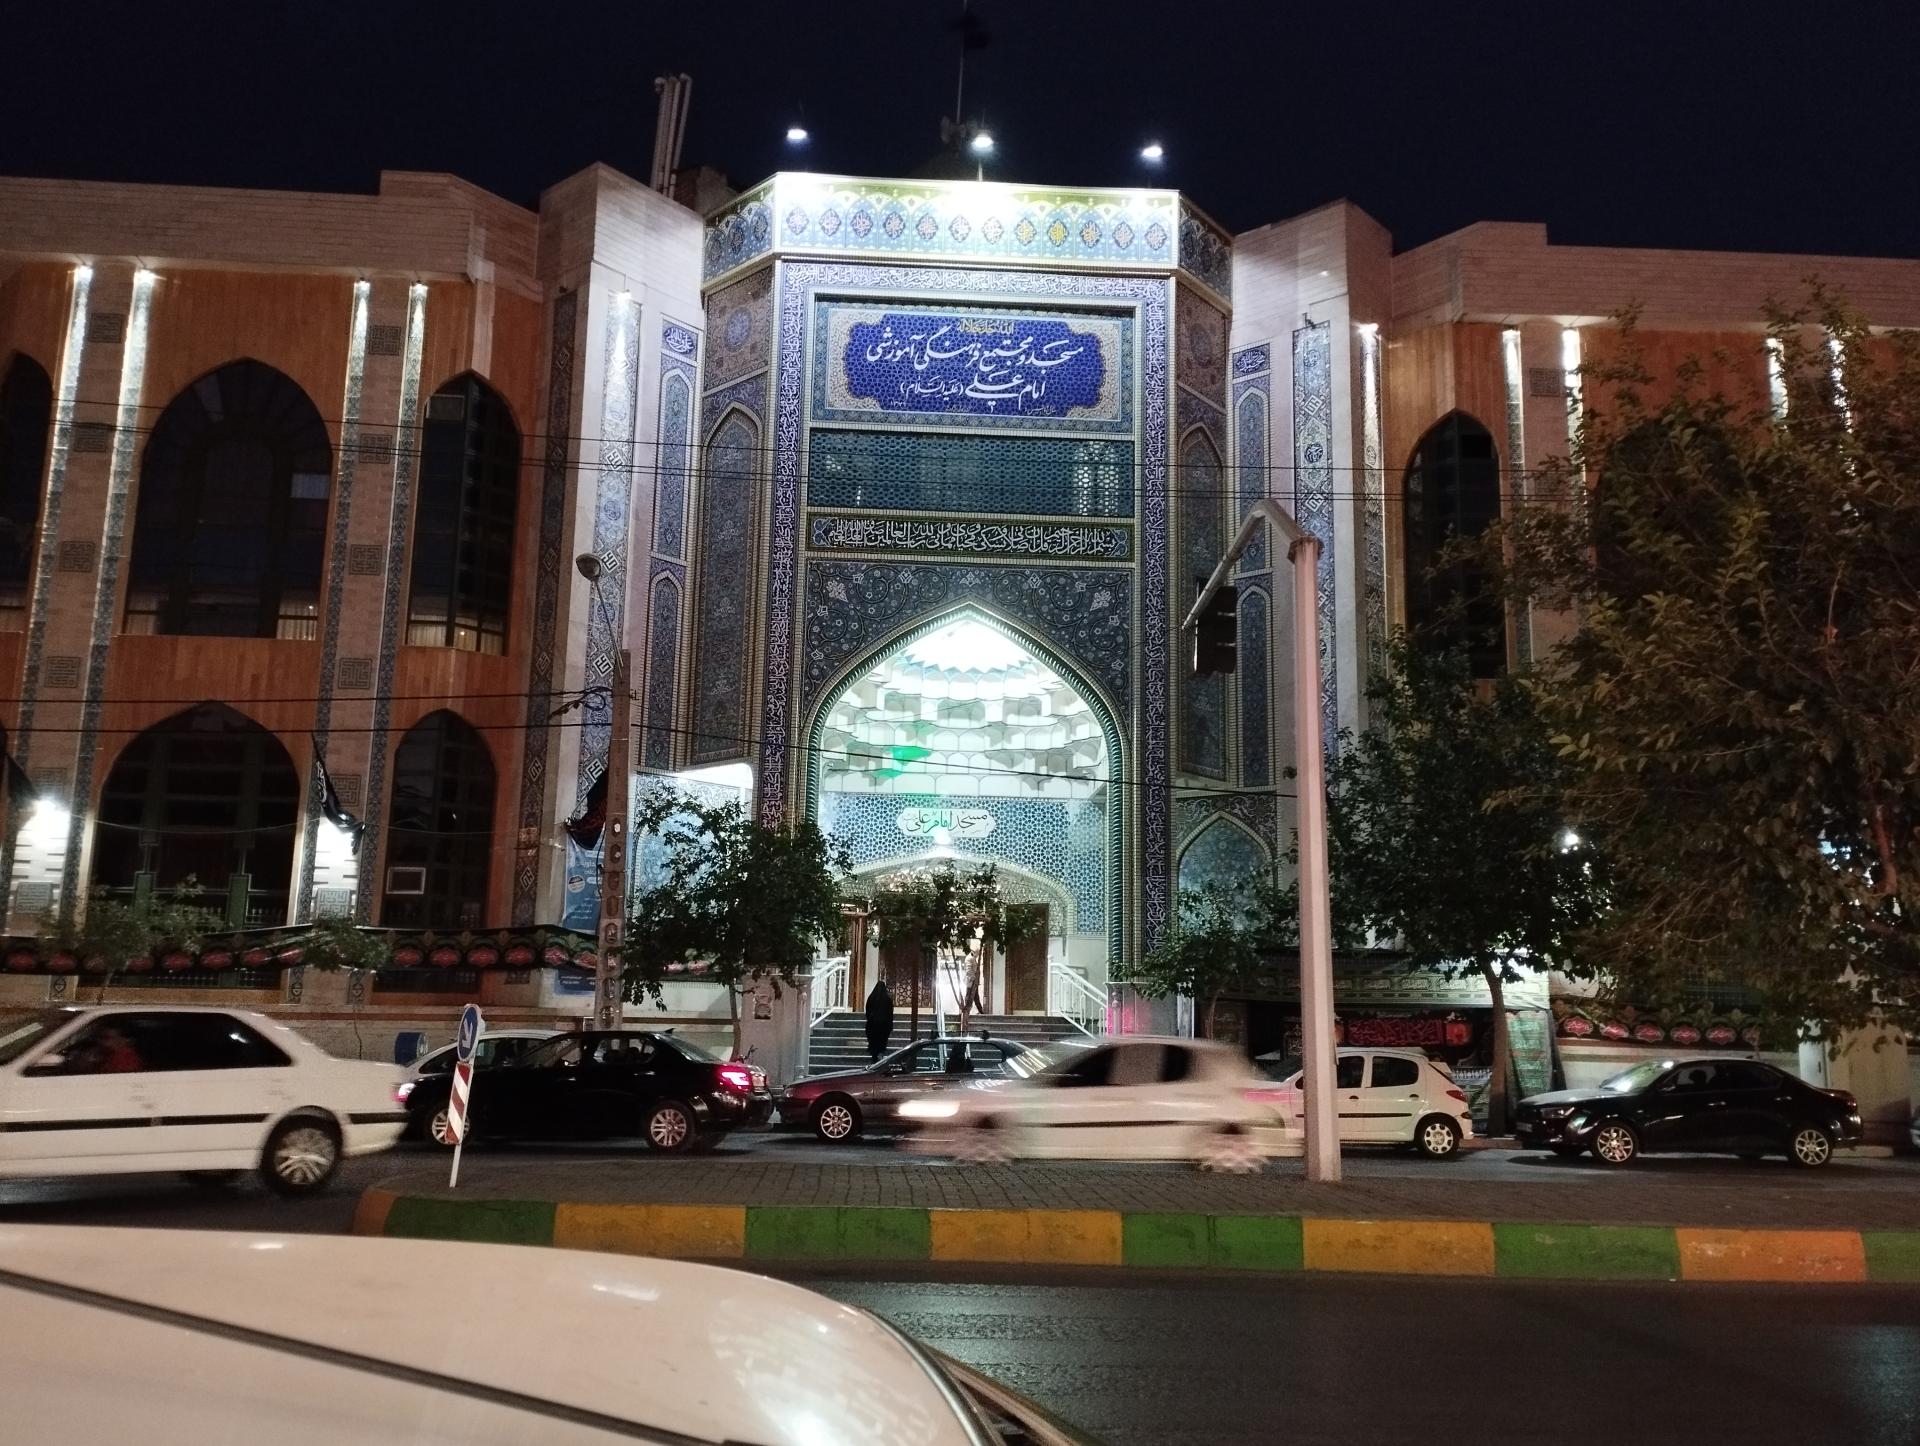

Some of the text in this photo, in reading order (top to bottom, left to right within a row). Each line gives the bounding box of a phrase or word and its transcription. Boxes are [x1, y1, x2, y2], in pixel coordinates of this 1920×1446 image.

[866, 325, 1084, 375] مسجد و مجتمع فرهنگی آموزشی
[964, 372, 1025, 408] علی
[1017, 380, 1047, 411] امام
[906, 809, 931, 832] علی
[922, 810, 953, 834] امام
[948, 811, 988, 834] مسجد
